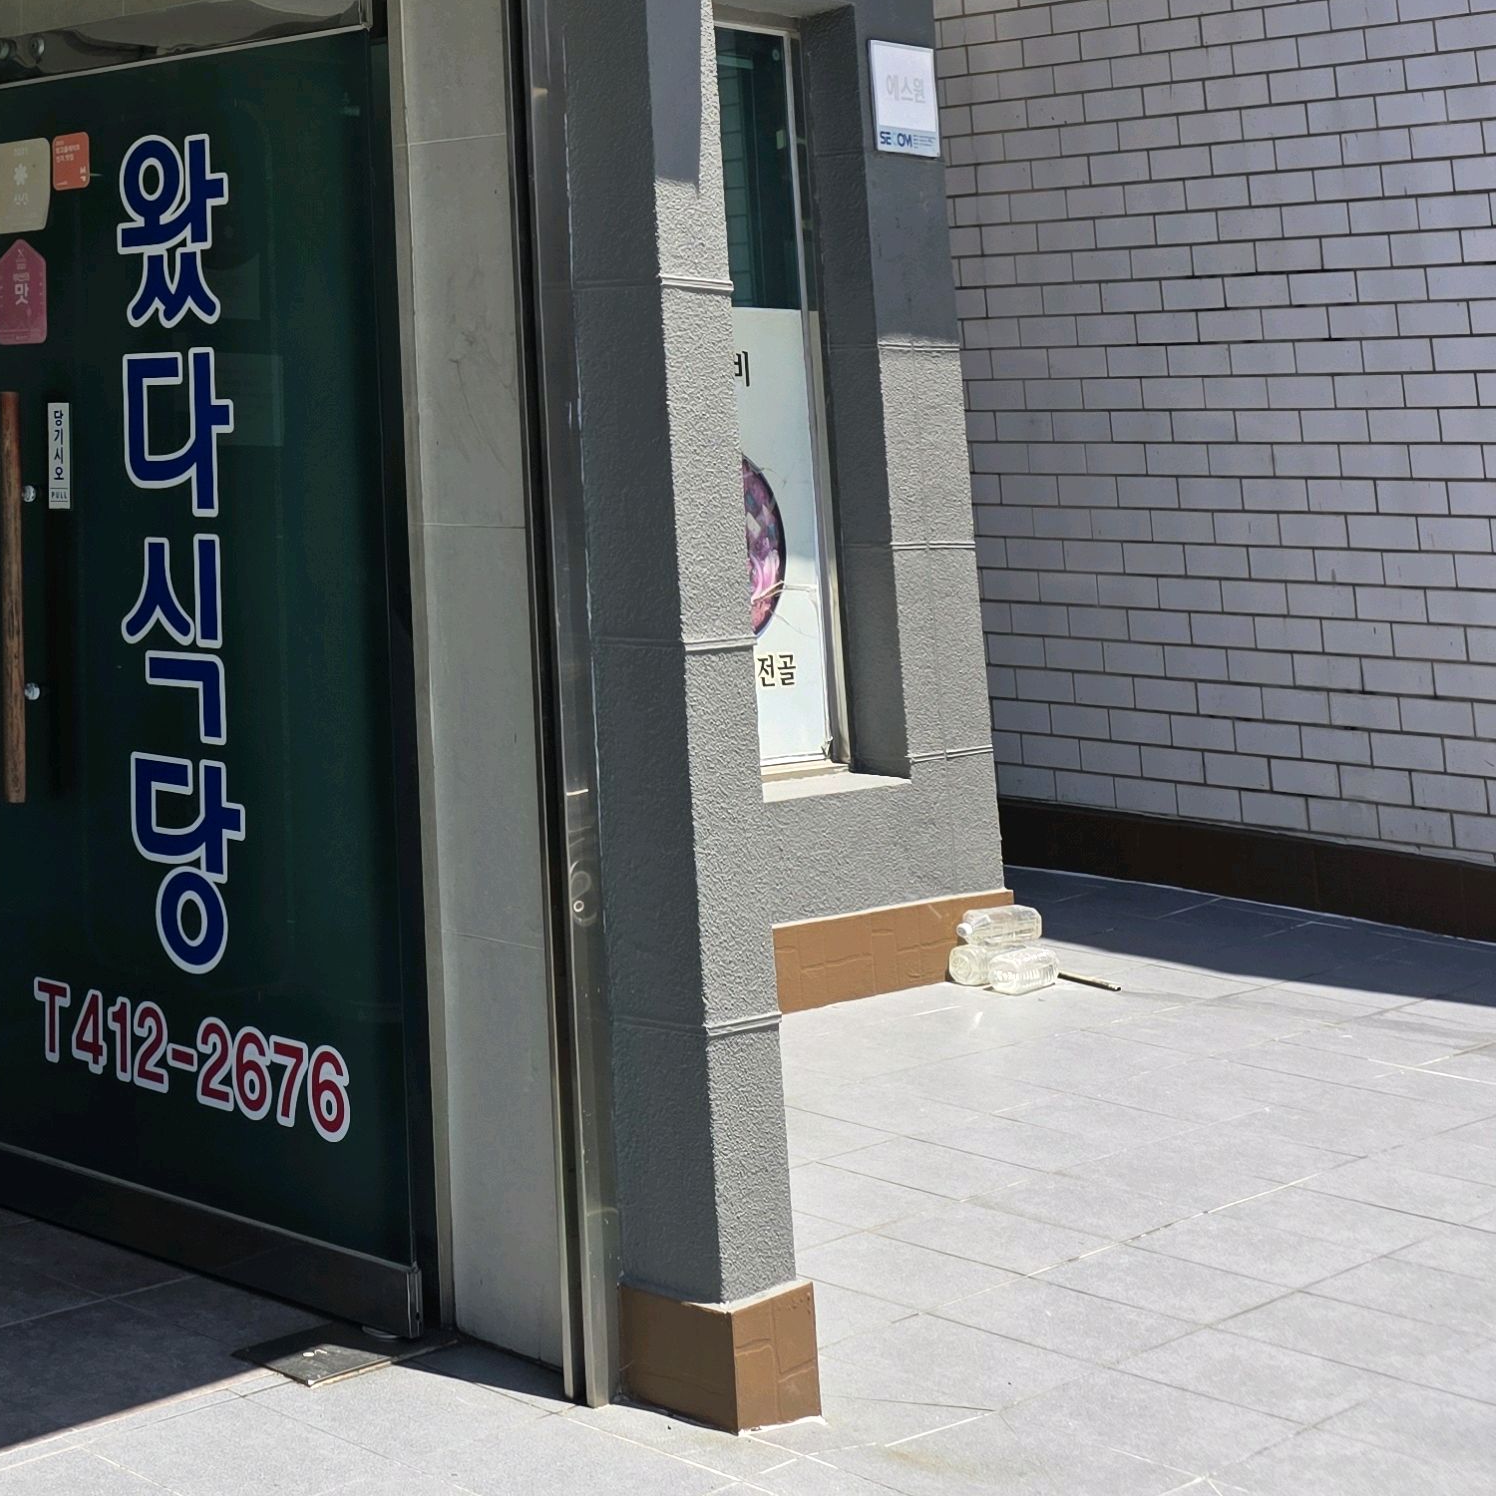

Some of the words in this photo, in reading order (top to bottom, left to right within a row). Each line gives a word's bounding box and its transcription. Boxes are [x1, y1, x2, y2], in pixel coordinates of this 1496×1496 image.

[886, 74, 927, 104] 에스원
[880, 131, 913, 149] SEOM
[53, 410, 64, 481] 당기시오
[51, 490, 68, 500] PULL
[117, 134, 245, 974] 왔다식당
[757, 654, 796, 687] 전골
